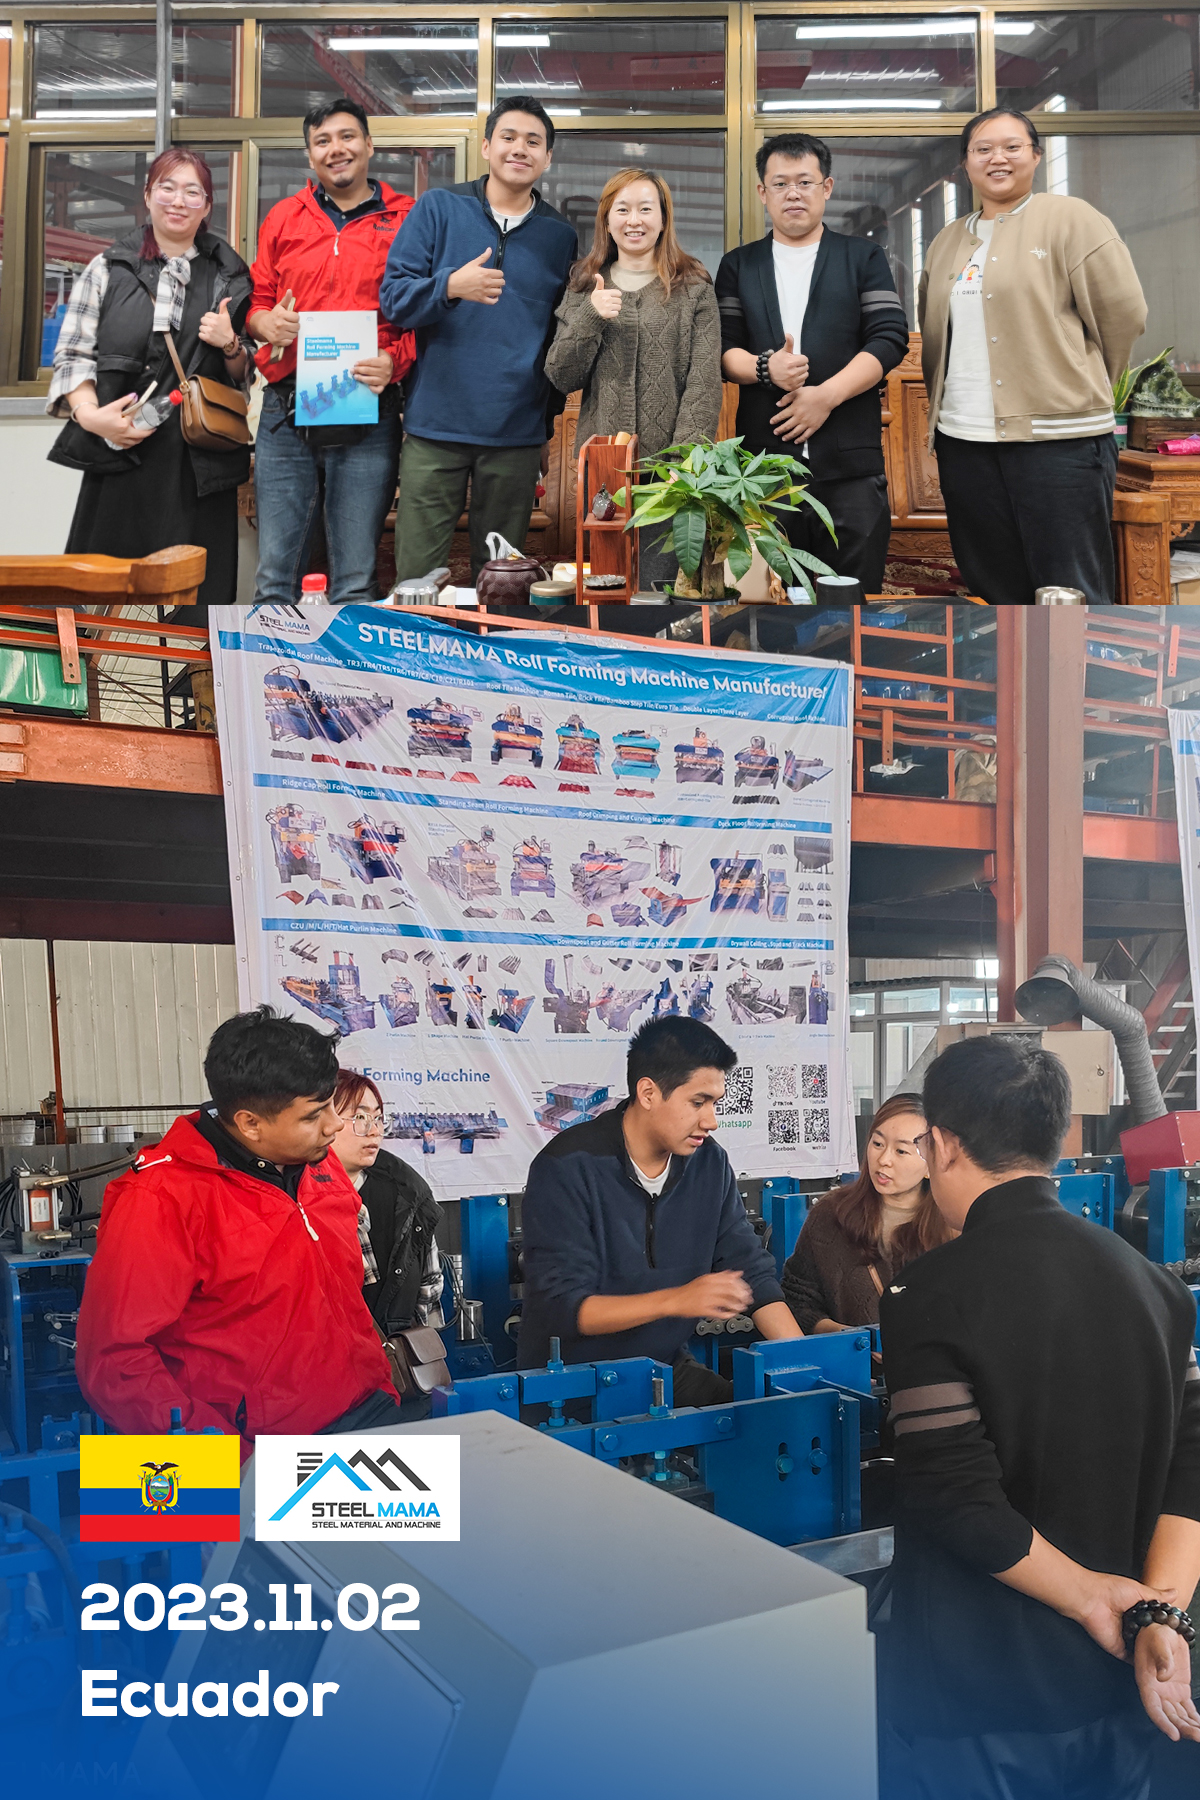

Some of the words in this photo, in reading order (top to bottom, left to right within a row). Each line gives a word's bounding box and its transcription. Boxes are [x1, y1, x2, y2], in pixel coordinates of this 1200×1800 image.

[284, 621, 311, 631] MAMA
[297, 651, 314, 661] Roof
[358, 622, 502, 663] STEELMAMA
[504, 649, 544, 671] Roll
[547, 656, 627, 687] Forming
[630, 666, 710, 690] Machine
[713, 674, 828, 700] Manufacturer
[282, 778, 302, 788] Ridge
[303, 780, 316, 790] Cap
[438, 798, 468, 809] Standing
[468, 801, 484, 809] Seam
[485, 803, 498, 811] Roll
[498, 804, 523, 814] Forming
[524, 806, 549, 815] Machine
[578, 811, 592, 819] Roof
[618, 813, 630, 821] and
[630, 815, 651, 824] Curving
[652, 816, 676, 824] Machine
[290, 922, 304, 930] CZU
[370, 925, 398, 934] Machine
[363, 1067, 422, 1086] Forming
[426, 1068, 491, 1083] Machine
